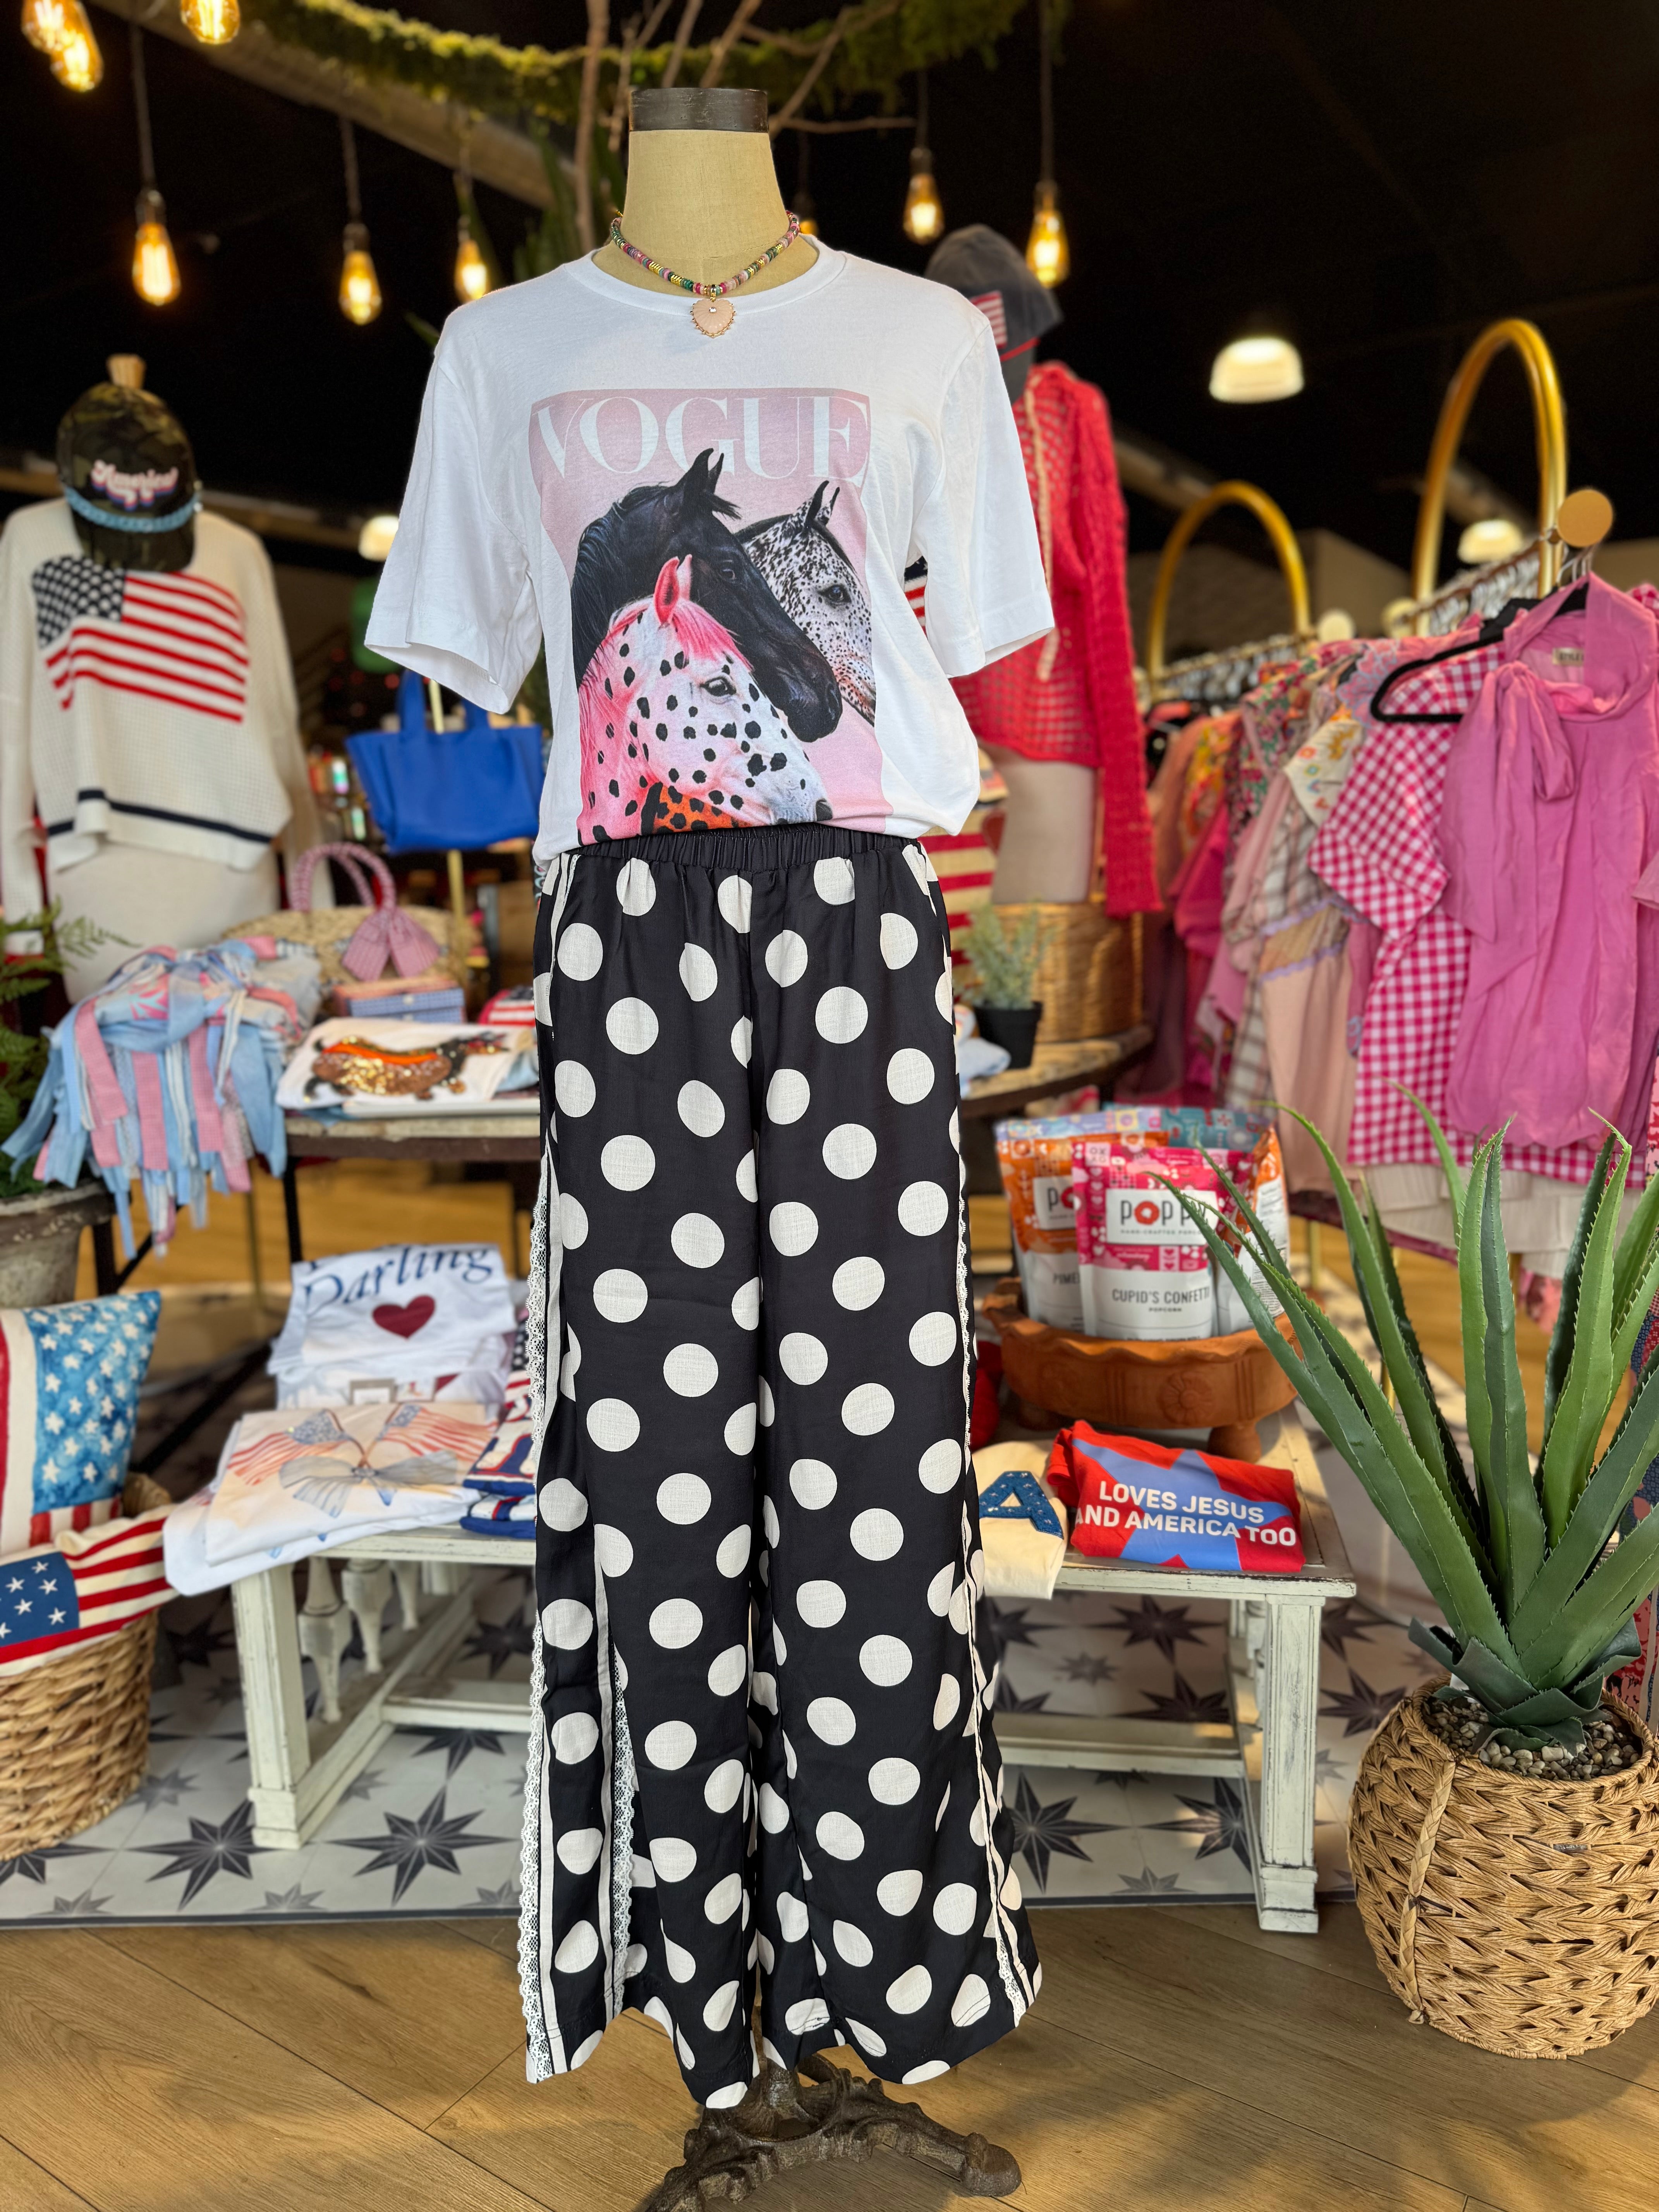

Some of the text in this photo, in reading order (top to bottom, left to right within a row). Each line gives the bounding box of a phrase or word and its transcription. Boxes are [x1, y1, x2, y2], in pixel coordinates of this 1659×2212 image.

[532, 396, 869, 487] VOGUE
[304, 1246, 492, 1317] Darling
[1112, 1288, 1159, 1304] CUPID'S
[1099, 1480, 1264, 1523] LOVES JESUS
[1075, 1504, 1296, 1546] AND AMERICA TOO
